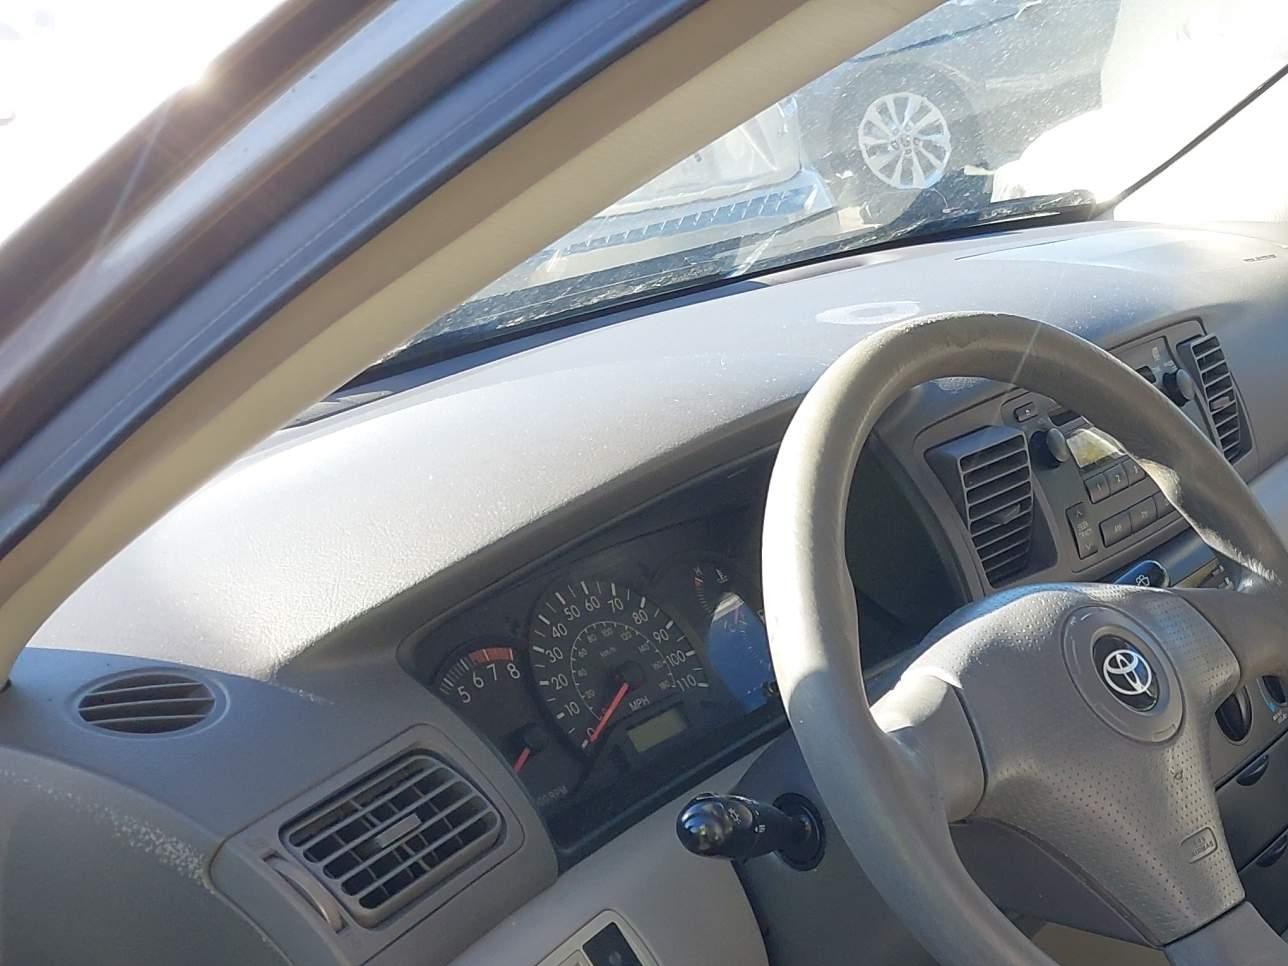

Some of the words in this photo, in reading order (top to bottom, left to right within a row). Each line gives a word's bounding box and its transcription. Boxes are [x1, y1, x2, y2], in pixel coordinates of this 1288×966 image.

[585, 596, 601, 612] 60
[608, 598, 624, 614] 70
[563, 605, 580, 621] 50
[632, 609, 649, 625] 80
[552, 623, 568, 638] 40
[652, 628, 669, 644] 90
[545, 647, 564, 663] 30
[666, 650, 687, 667] 100
[486, 663, 497, 680] 7
[506, 663, 521, 679] 8
[472, 671, 485, 688] 6
[551, 673, 568, 690] 20
[676, 674, 697, 692] 110
[457, 685, 471, 703] 5
[564, 701, 580, 716] 10
[628, 695, 650, 712] MPH
